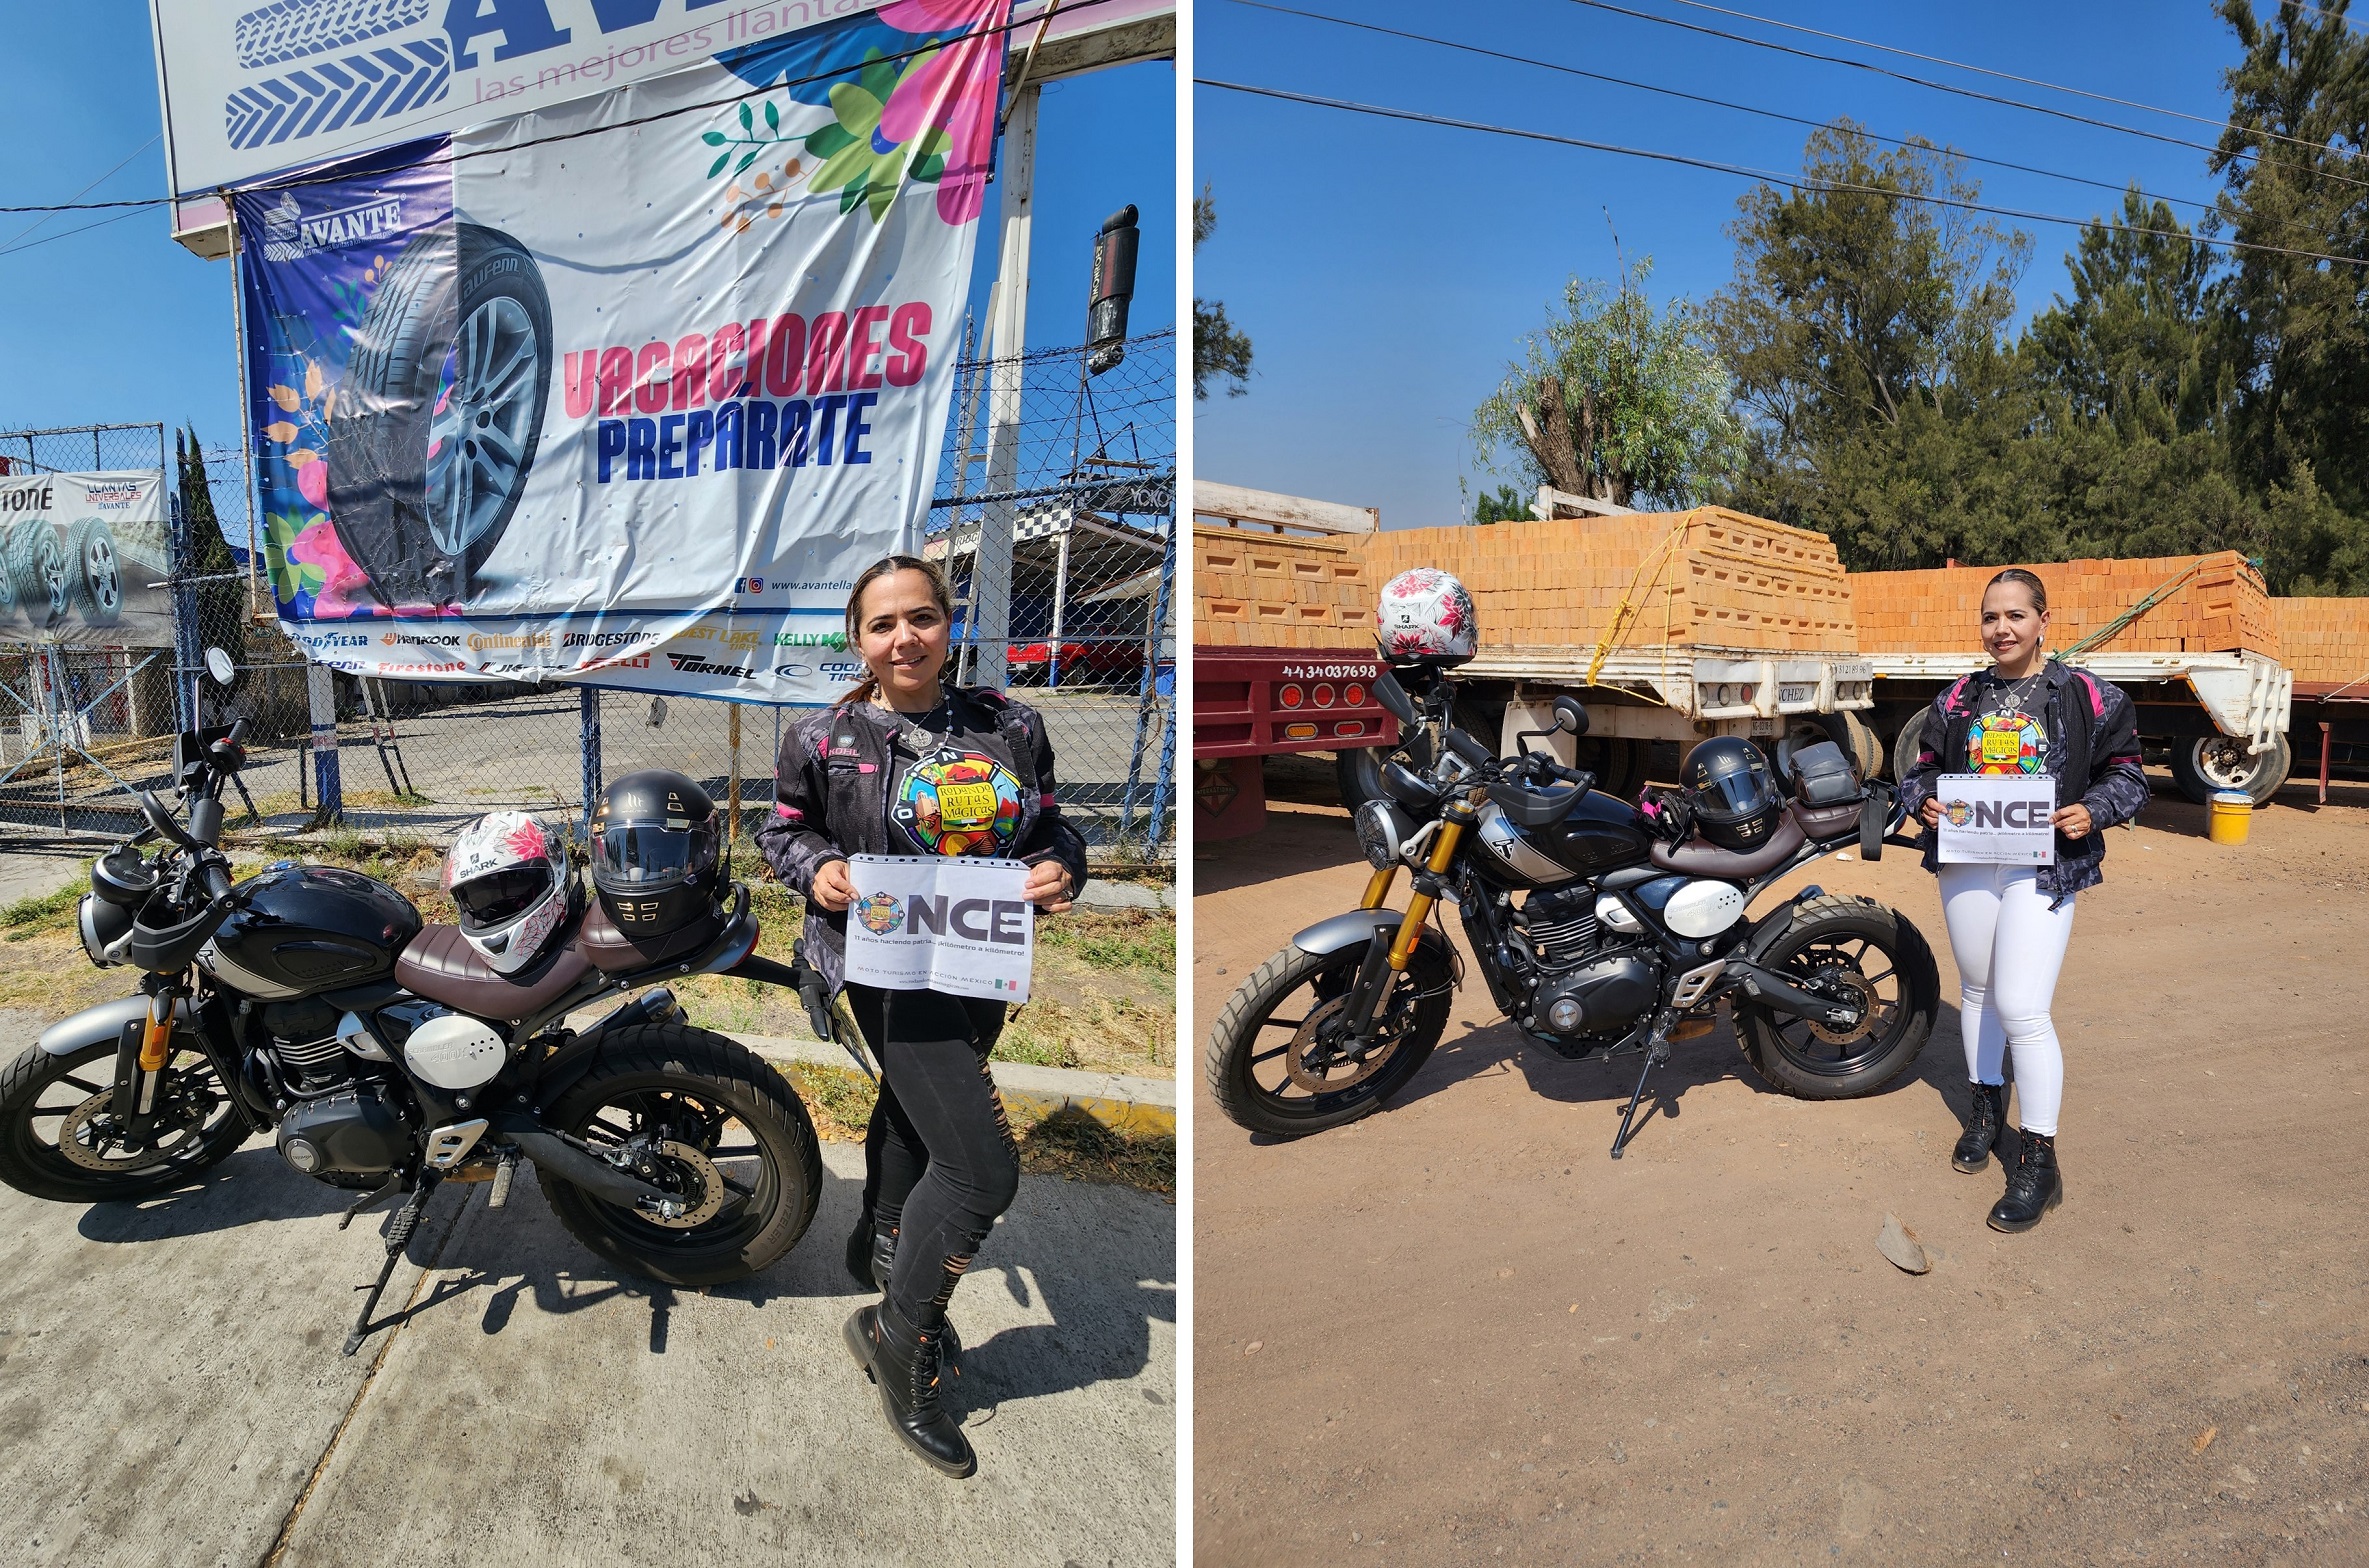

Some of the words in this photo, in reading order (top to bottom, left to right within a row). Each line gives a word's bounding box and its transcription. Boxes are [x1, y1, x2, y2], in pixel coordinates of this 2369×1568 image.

[475, 71, 525, 104] las
[538, 27, 712, 90] mejores
[301, 201, 400, 250] AVANTE
[564, 301, 932, 420] VACACIONES
[597, 381, 878, 484] PREPÁRATE
[87, 482, 137, 493] LLANTAS
[85, 491, 141, 502] UNIVERSALES
[467, 630, 550, 651] Continental
[562, 632, 660, 647] BRIDGESTONE
[729, 643, 757, 651] TIRES
[774, 632, 820, 647] KELLY
[378, 661, 467, 675] Firestone
[666, 653, 757, 680] TORNEL
[1779, 687, 1804, 702] CHEZ
[942, 751, 958, 761] N
[460, 858, 498, 878] SHARK
[857, 966, 880, 974] MOTO
